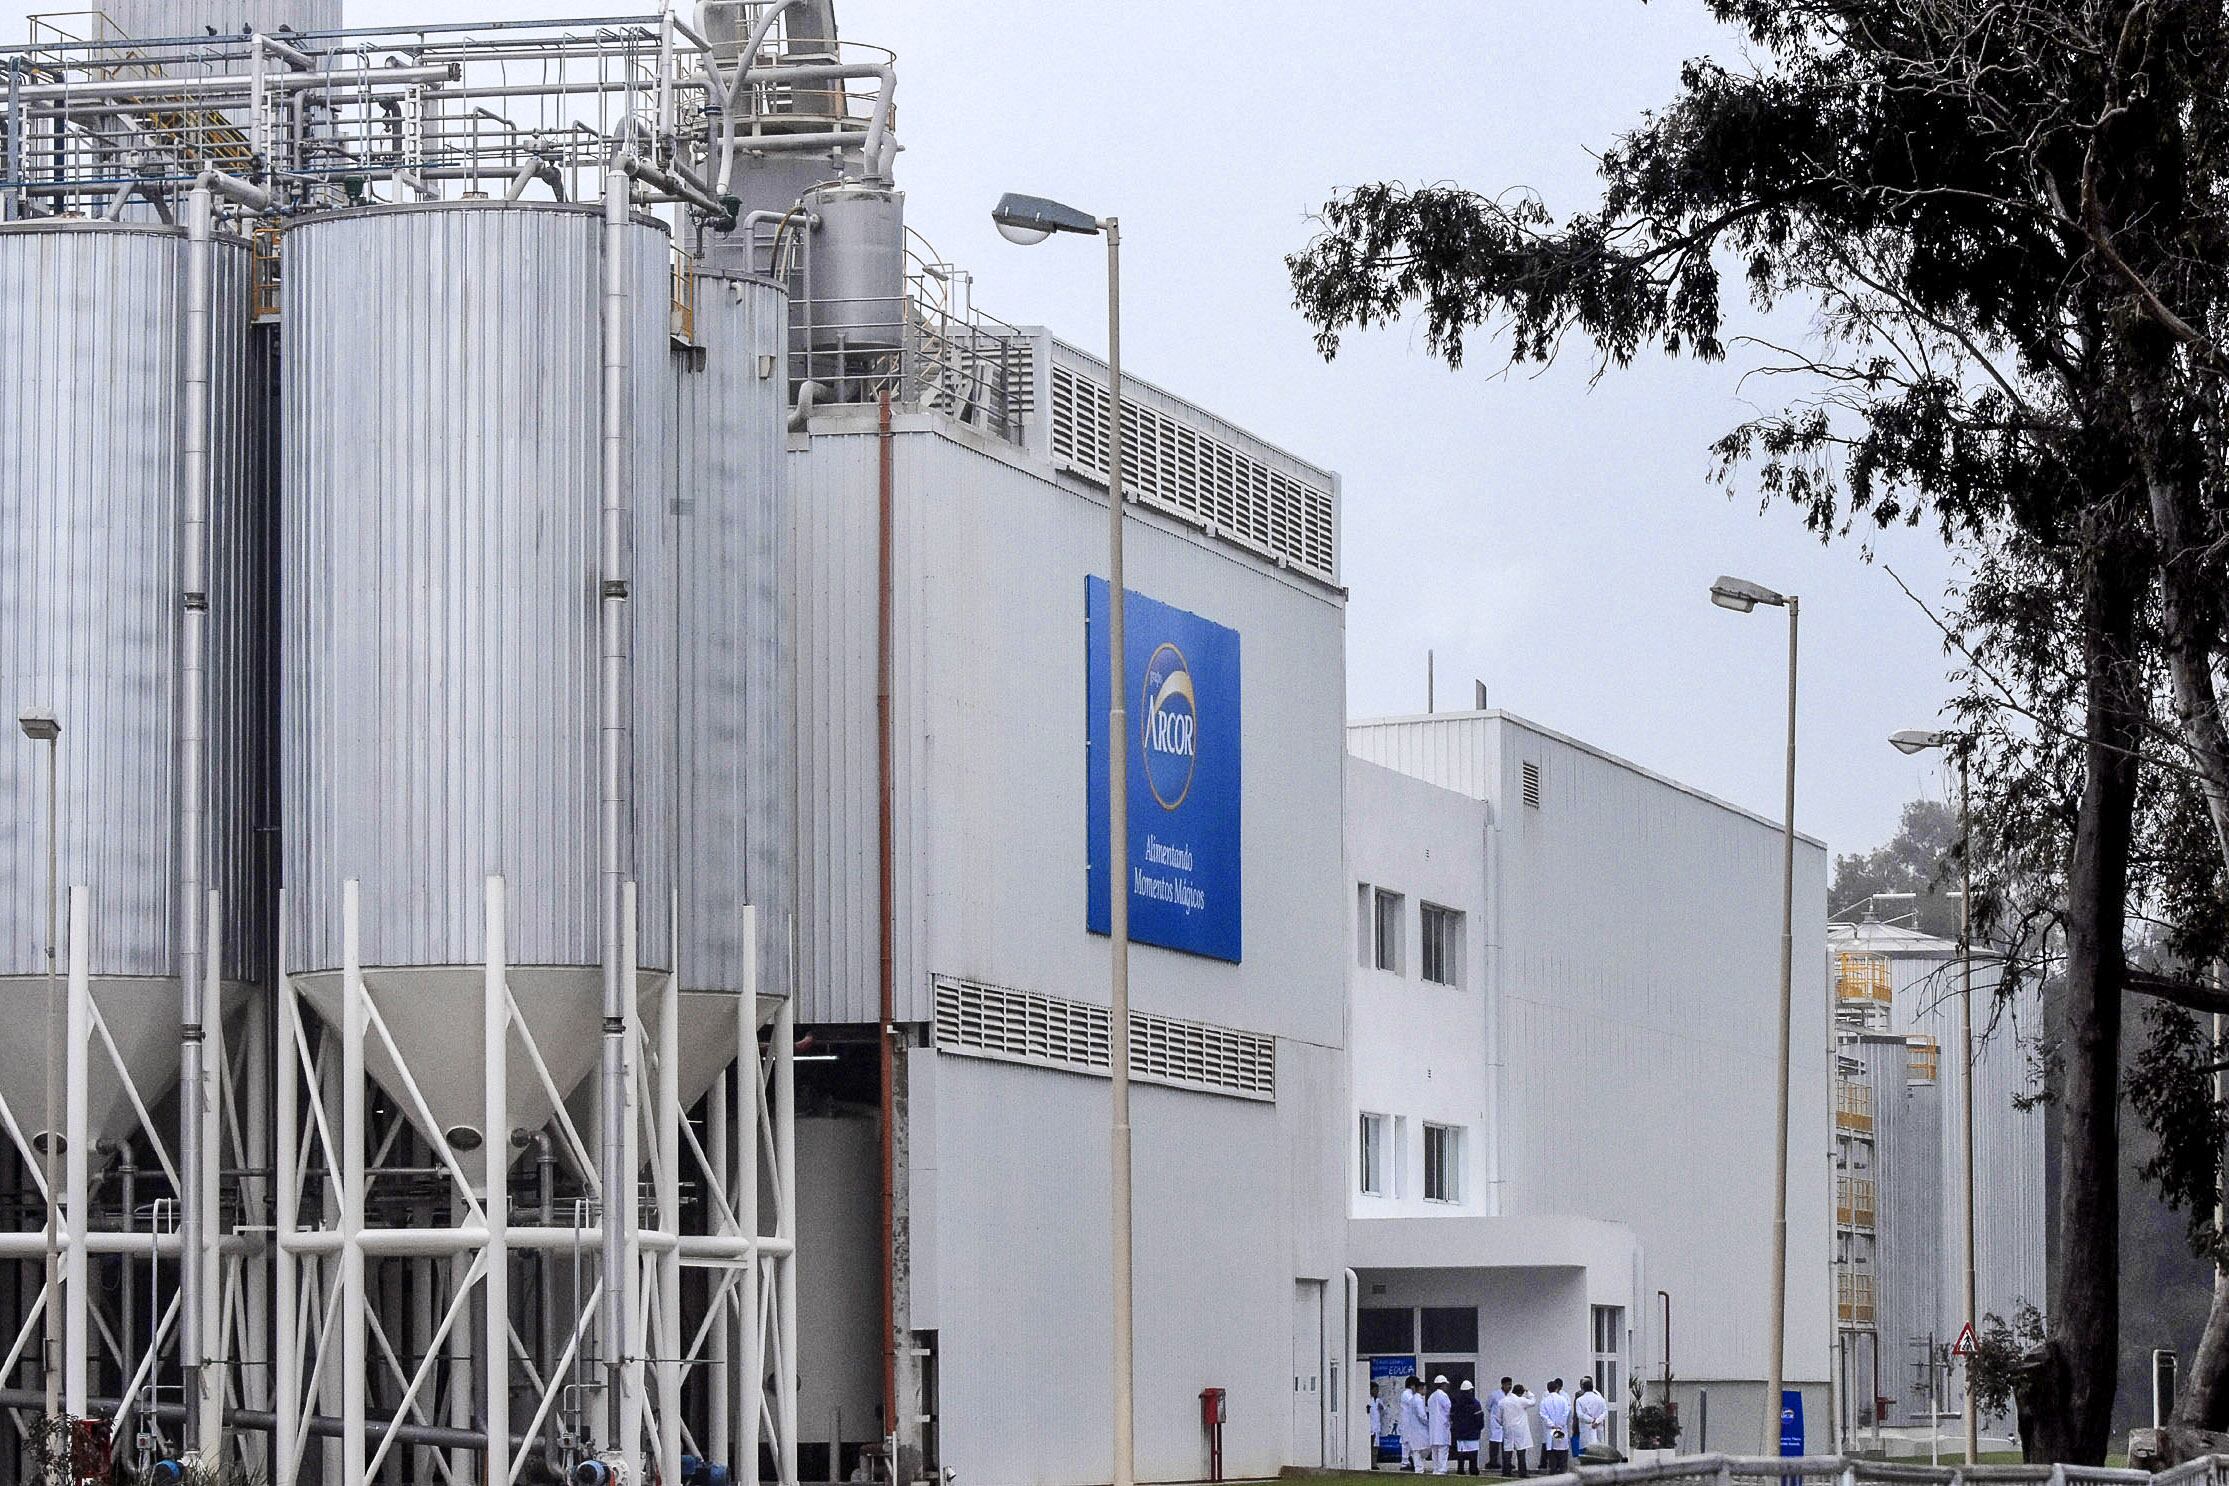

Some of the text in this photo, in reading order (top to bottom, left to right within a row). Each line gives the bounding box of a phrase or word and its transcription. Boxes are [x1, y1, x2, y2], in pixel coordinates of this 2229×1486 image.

[1145, 695, 1193, 756] ARCOR
[1145, 834, 1193, 872] Alimentando
[1134, 866, 1205, 915] Momentos Mágicos
